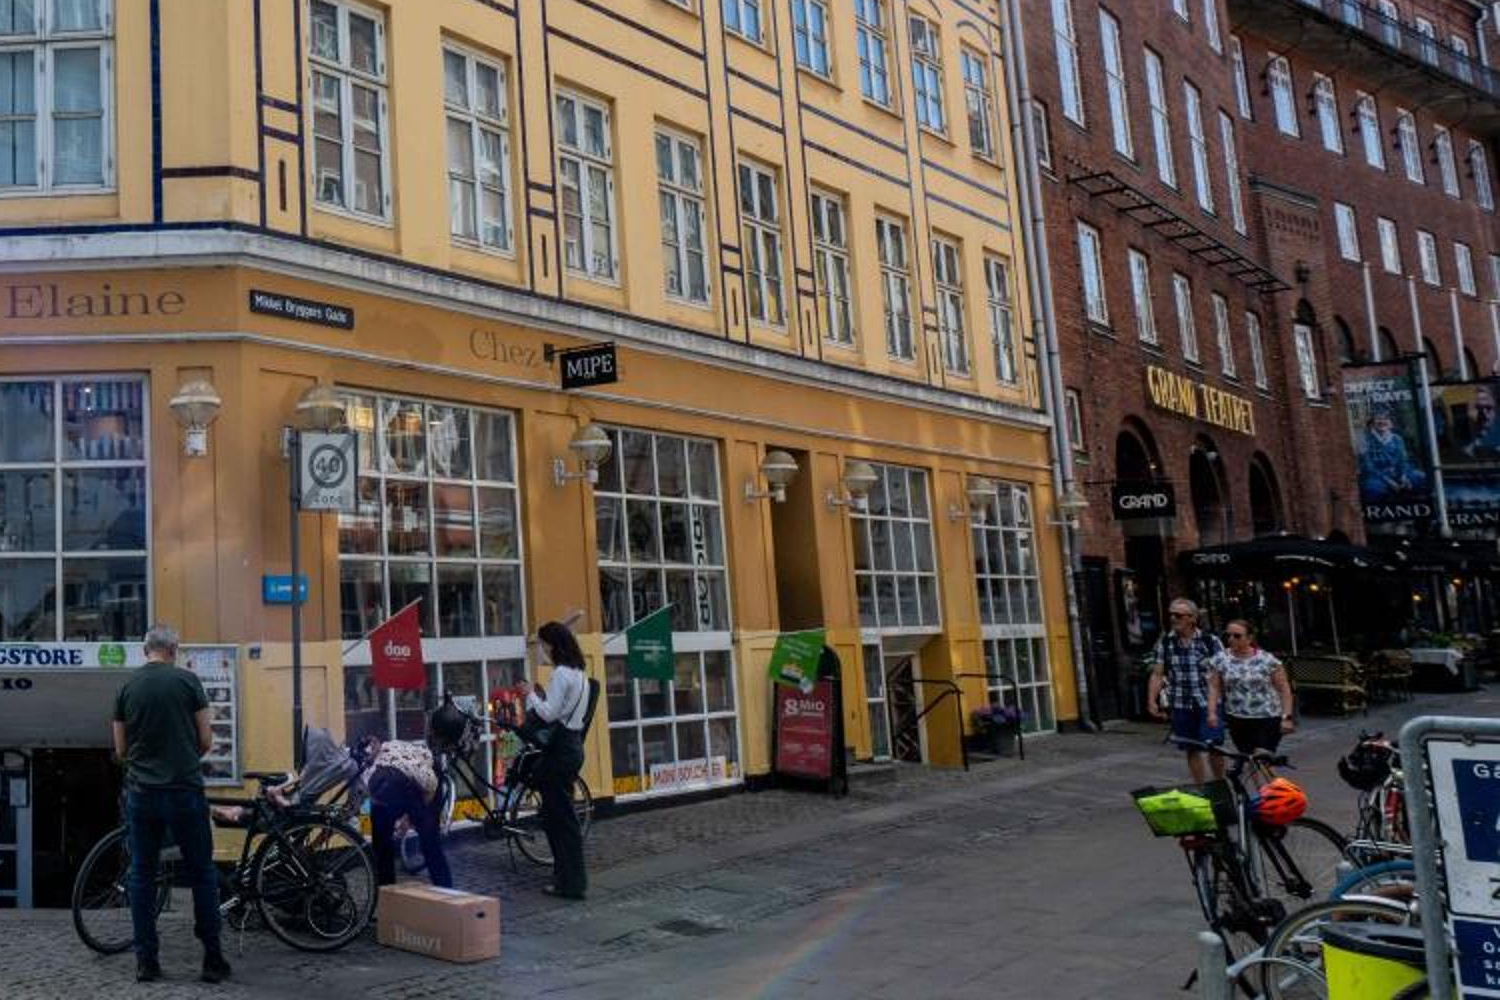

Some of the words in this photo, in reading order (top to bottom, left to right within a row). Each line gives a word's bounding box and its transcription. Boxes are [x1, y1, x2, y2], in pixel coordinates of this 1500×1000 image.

[4, 283, 186, 319] Elaine
[469, 327, 538, 368] Chez
[566, 352, 614, 378] MIPE
[1147, 365, 1197, 418] GRAND
[1200, 384, 1256, 436] TEATRET
[315, 456, 341, 475] 40
[1119, 493, 1168, 510] GRAND
